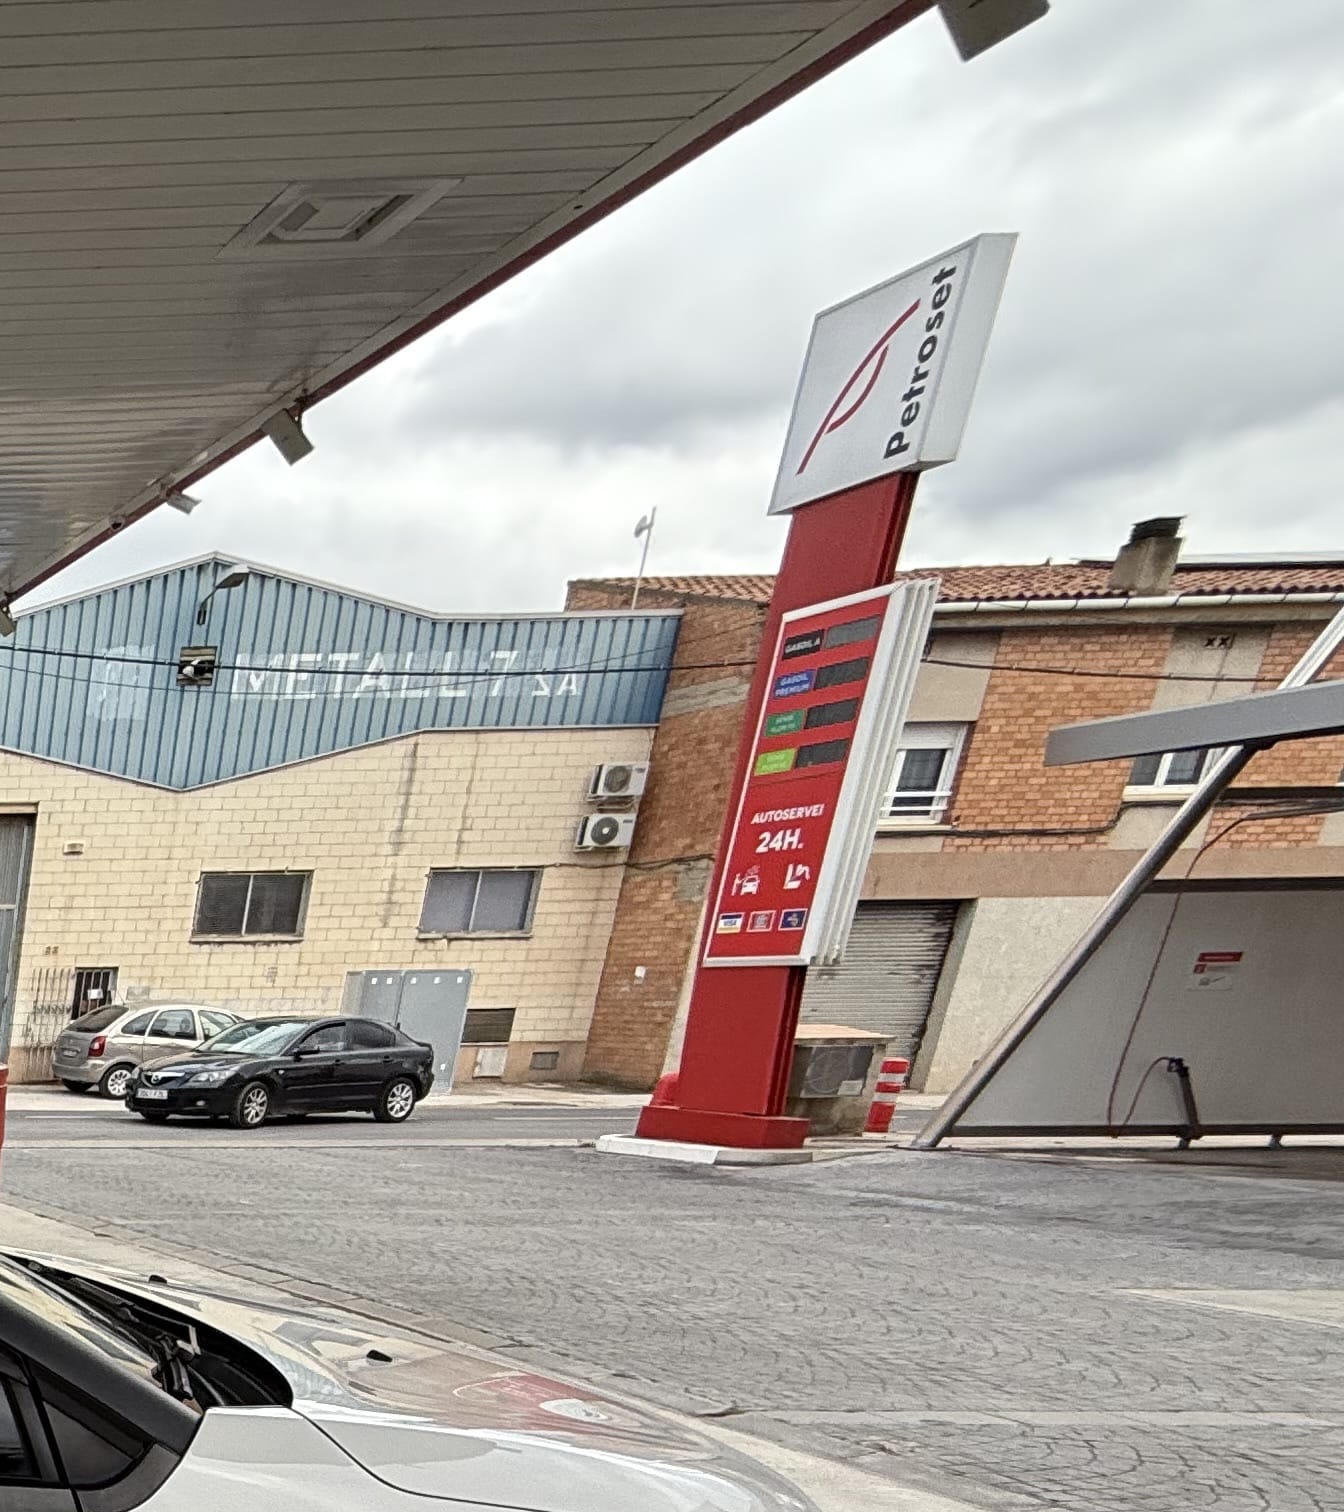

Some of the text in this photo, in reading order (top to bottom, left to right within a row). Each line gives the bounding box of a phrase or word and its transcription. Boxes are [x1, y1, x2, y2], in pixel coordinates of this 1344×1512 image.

[884, 264, 957, 459] Petroset
[750, 803, 825, 825] AUTOSERVEI
[755, 828, 804, 853] 24H.
